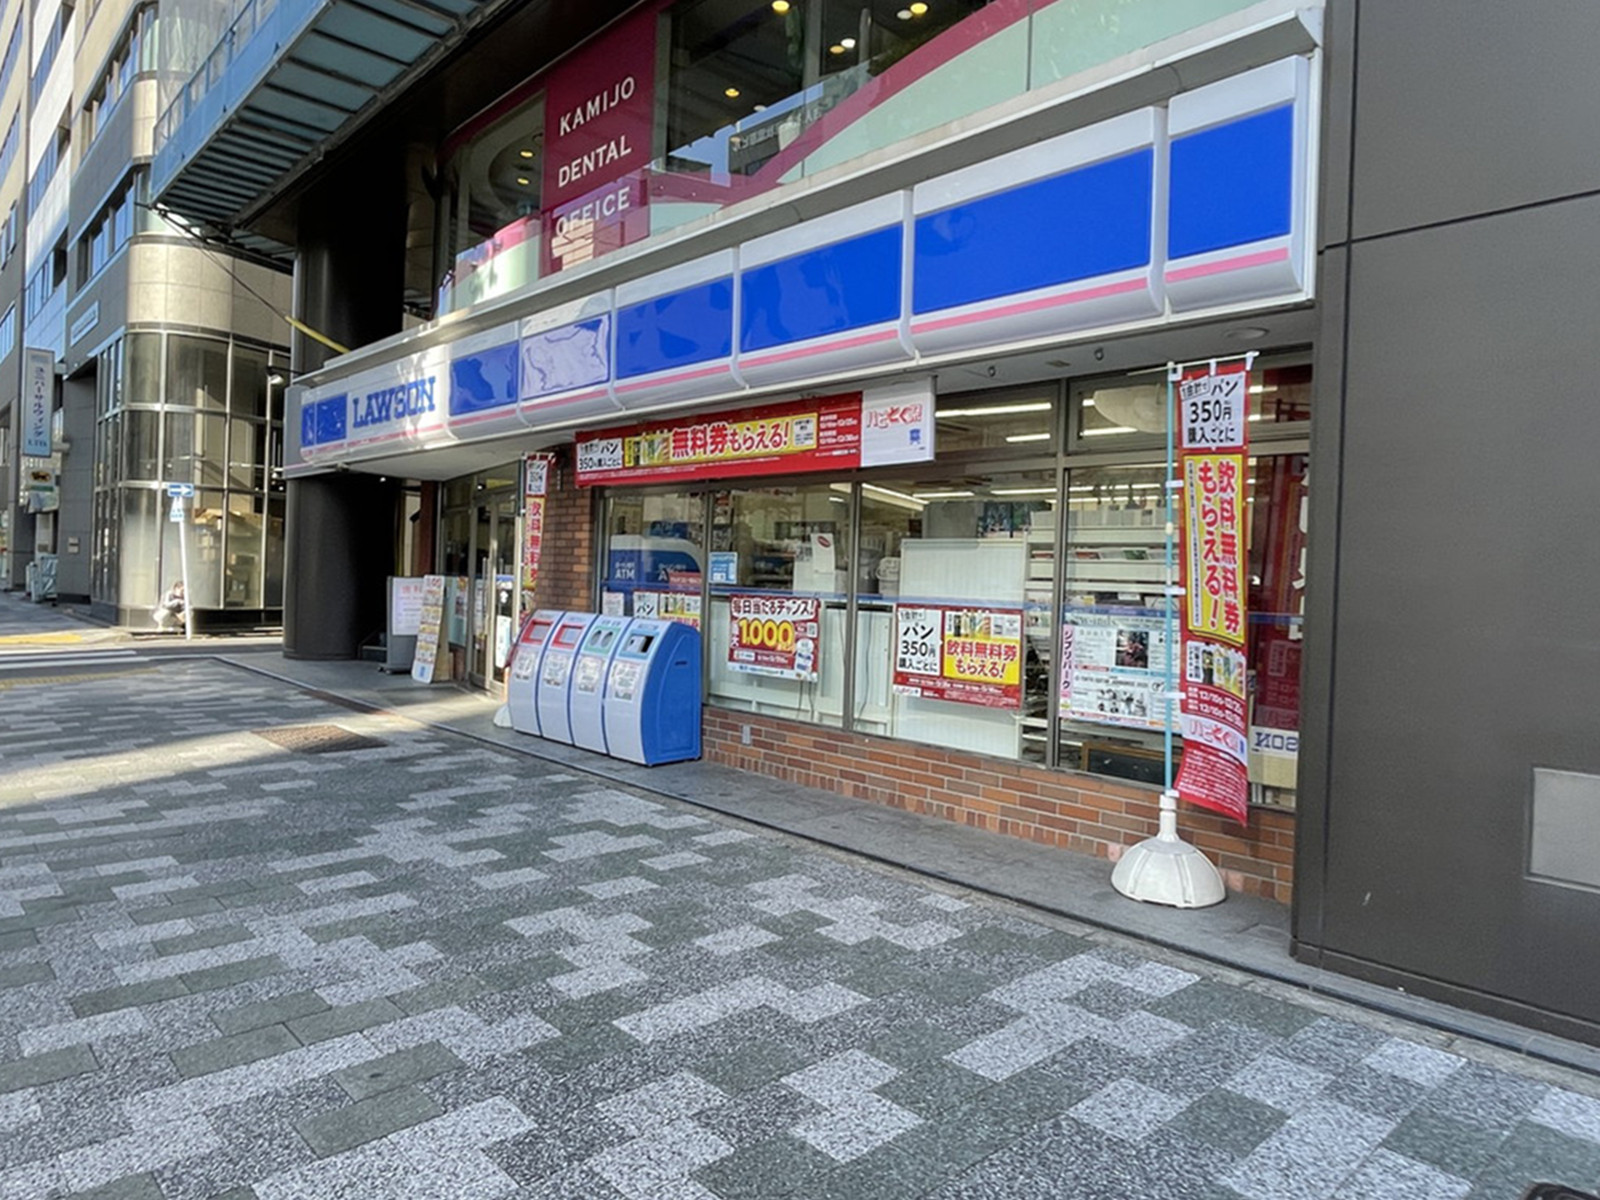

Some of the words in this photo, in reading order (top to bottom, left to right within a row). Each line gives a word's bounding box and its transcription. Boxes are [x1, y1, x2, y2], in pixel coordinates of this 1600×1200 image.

[559, 76, 636, 137] KAMIJO
[558, 135, 633, 188] DENTAL
[556, 187, 631, 238] OFFICE
[1211, 379, 1239, 398] パン
[353, 376, 436, 428] LAWSON
[1190, 400, 1232, 424] 350円
[601, 442, 619, 455] パン
[1218, 461, 1240, 634] 飲料無料券
[615, 568, 635, 580] ATM
[637, 602, 655, 615] パン
[903, 622, 934, 640] パン
[901, 640, 937, 658] 350円
[946, 640, 1017, 664] 飲料無料券
